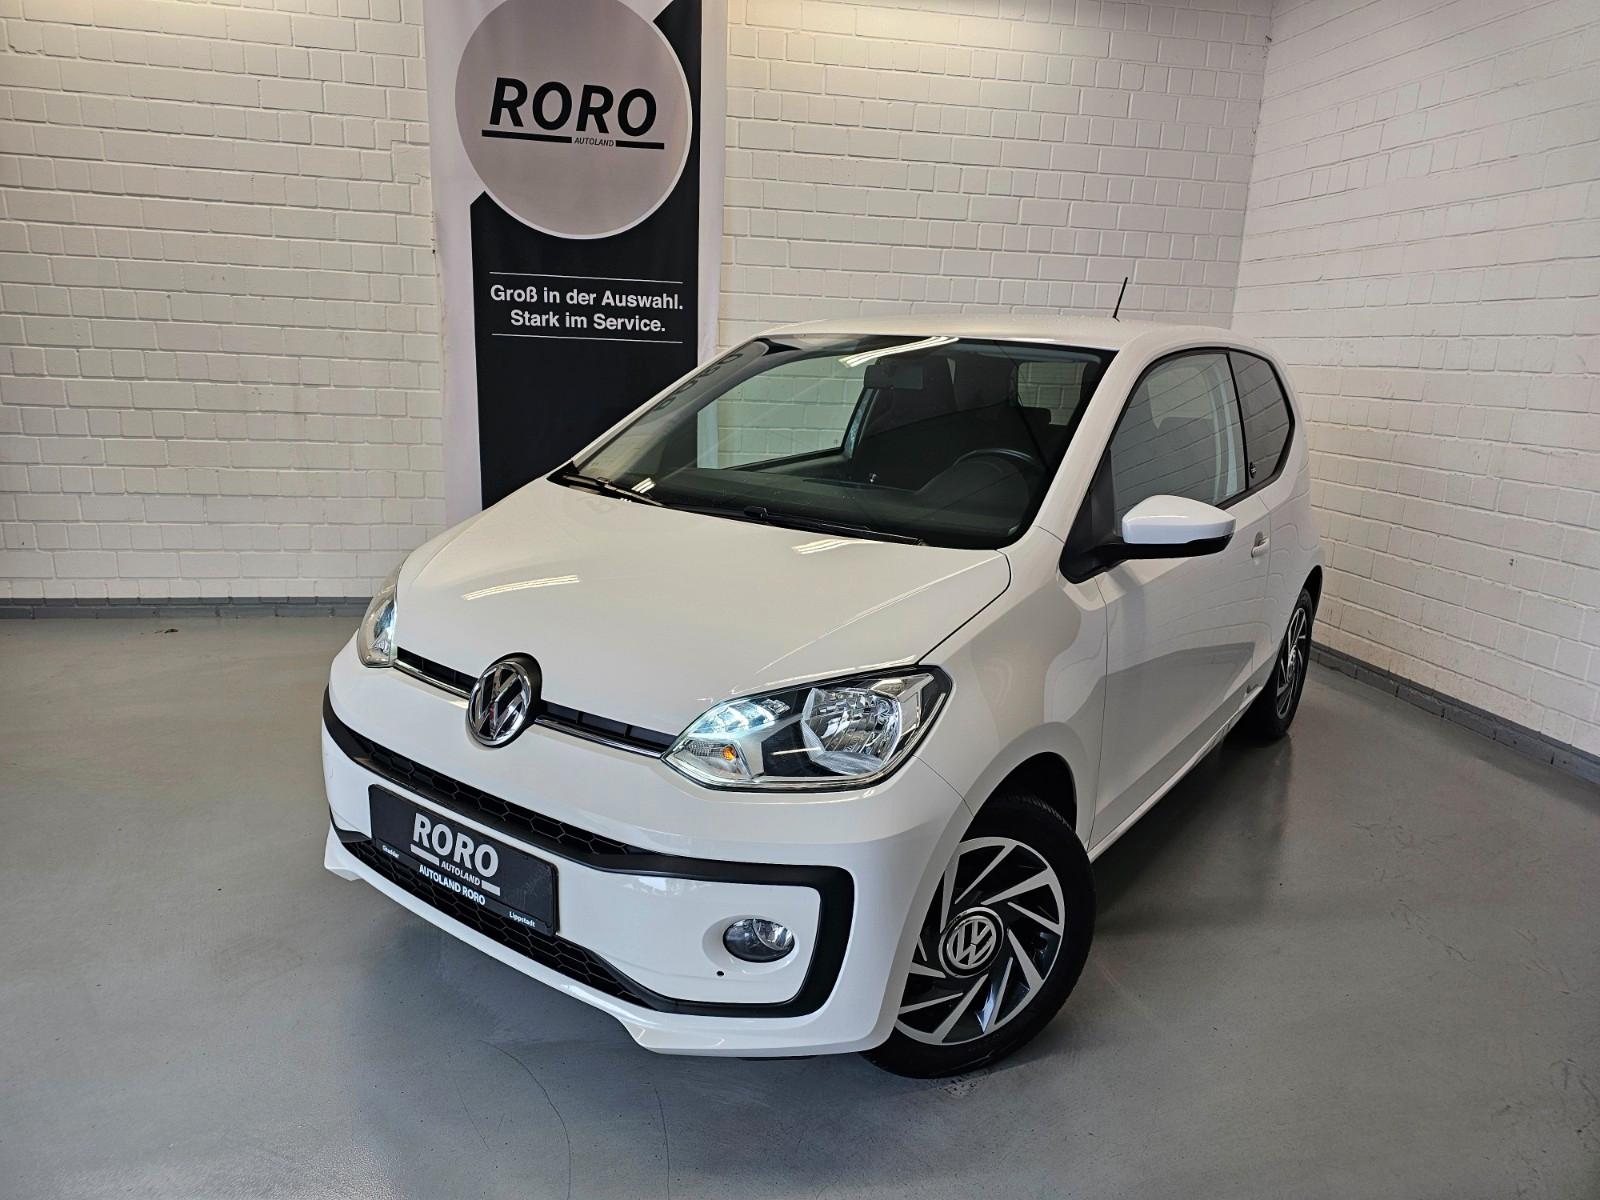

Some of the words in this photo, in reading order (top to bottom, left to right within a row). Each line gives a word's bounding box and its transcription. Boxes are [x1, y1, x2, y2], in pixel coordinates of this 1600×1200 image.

[489, 77, 657, 136] RORO
[574, 137, 614, 147] AUTOLAND
[490, 284, 538, 301] Groß
[543, 286, 560, 304] in
[566, 288, 597, 305] der
[601, 290, 684, 309] Auswahl.
[510, 309, 560, 327] Stark
[565, 311, 588, 328] im
[593, 313, 666, 332] Service.
[413, 812, 499, 878] RORO
[419, 864, 461, 893] AUTOLAND
[462, 886, 486, 906] RORO
[441, 860, 481, 887] AUTOLAND
